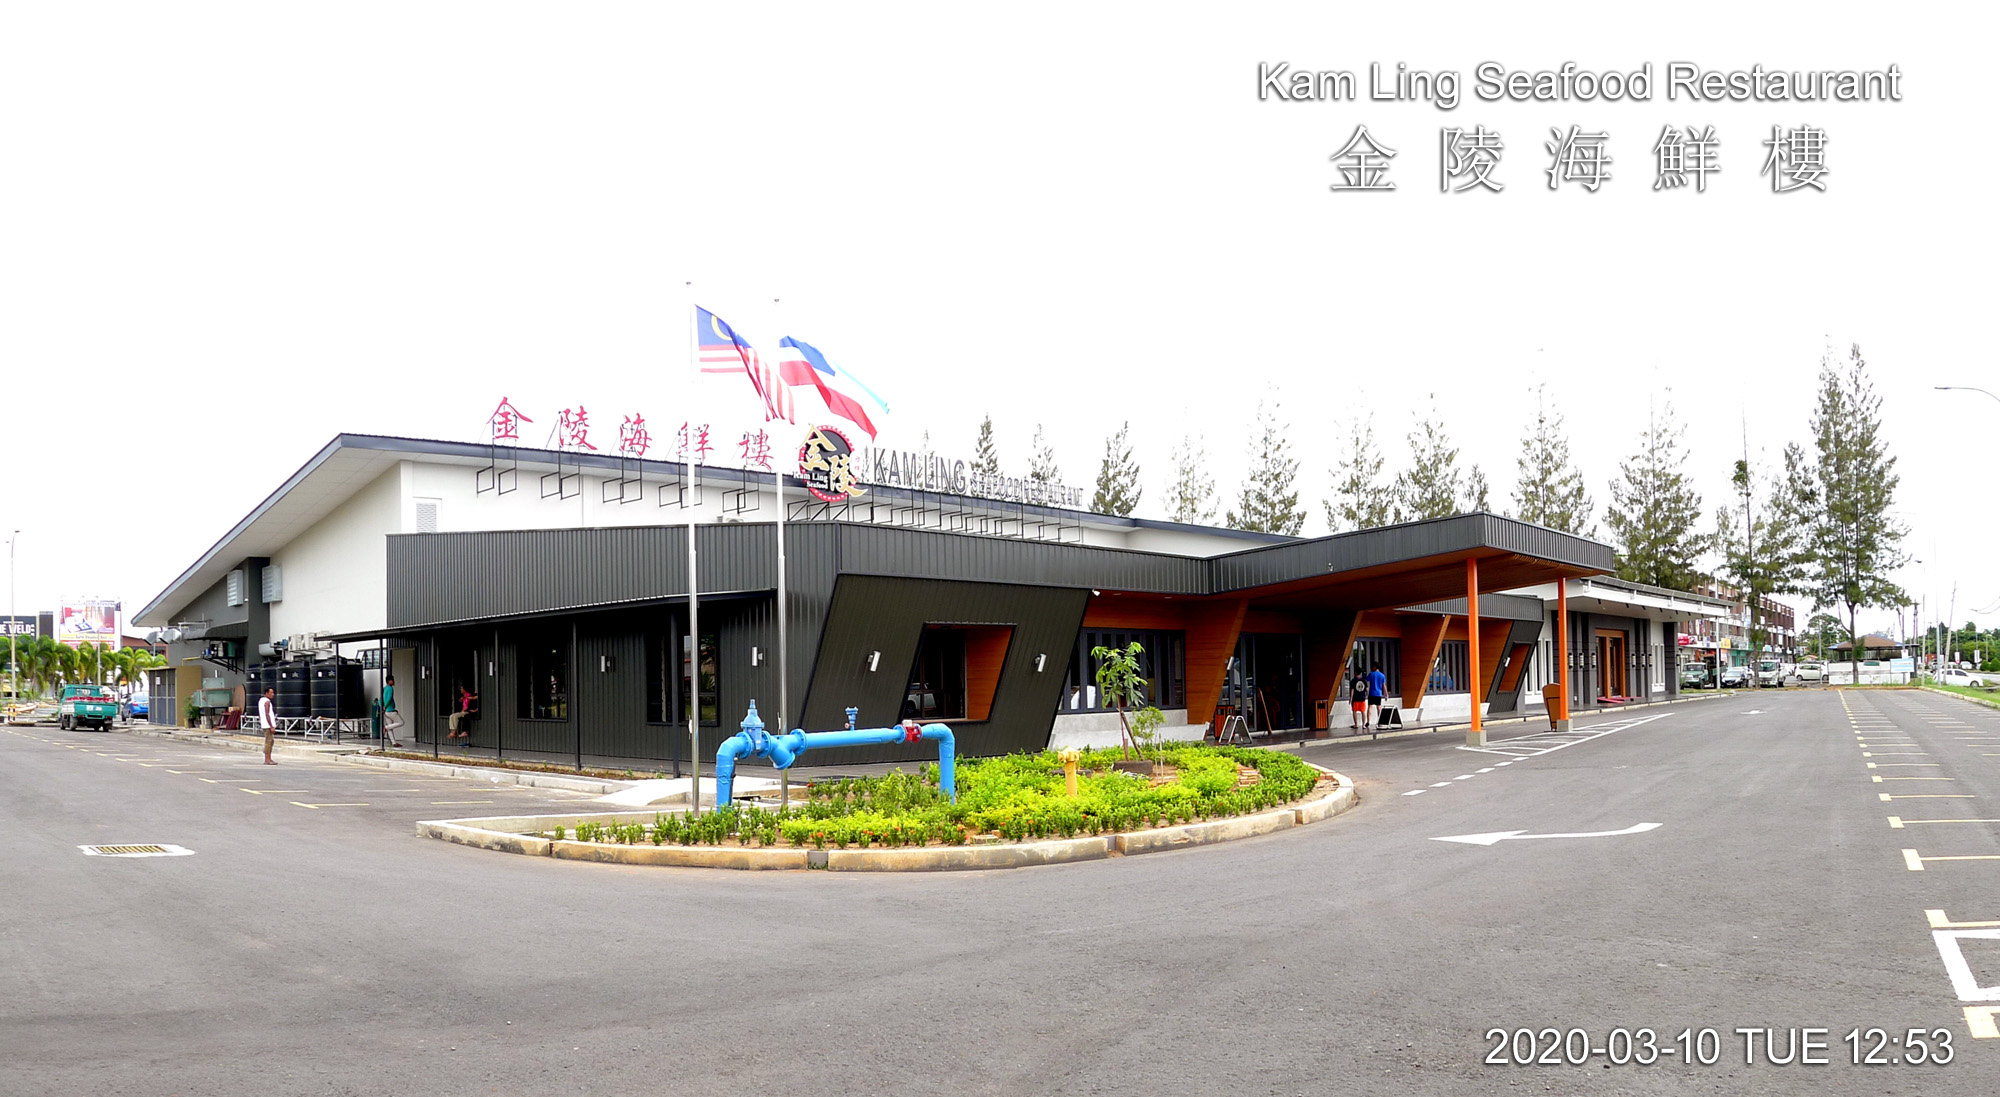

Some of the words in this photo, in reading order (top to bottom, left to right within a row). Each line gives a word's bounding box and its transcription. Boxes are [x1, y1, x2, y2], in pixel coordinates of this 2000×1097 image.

[486, 396, 772, 470] 金陵海鮮樓
[793, 471, 810, 480] Kam
[812, 473, 828, 483] Ling
[798, 423, 868, 497] 金陵
[806, 481, 828, 490] Seafood
[873, 447, 917, 487] KAM
[924, 454, 966, 494] LING
[970, 471, 1021, 500] SEAFOOD
